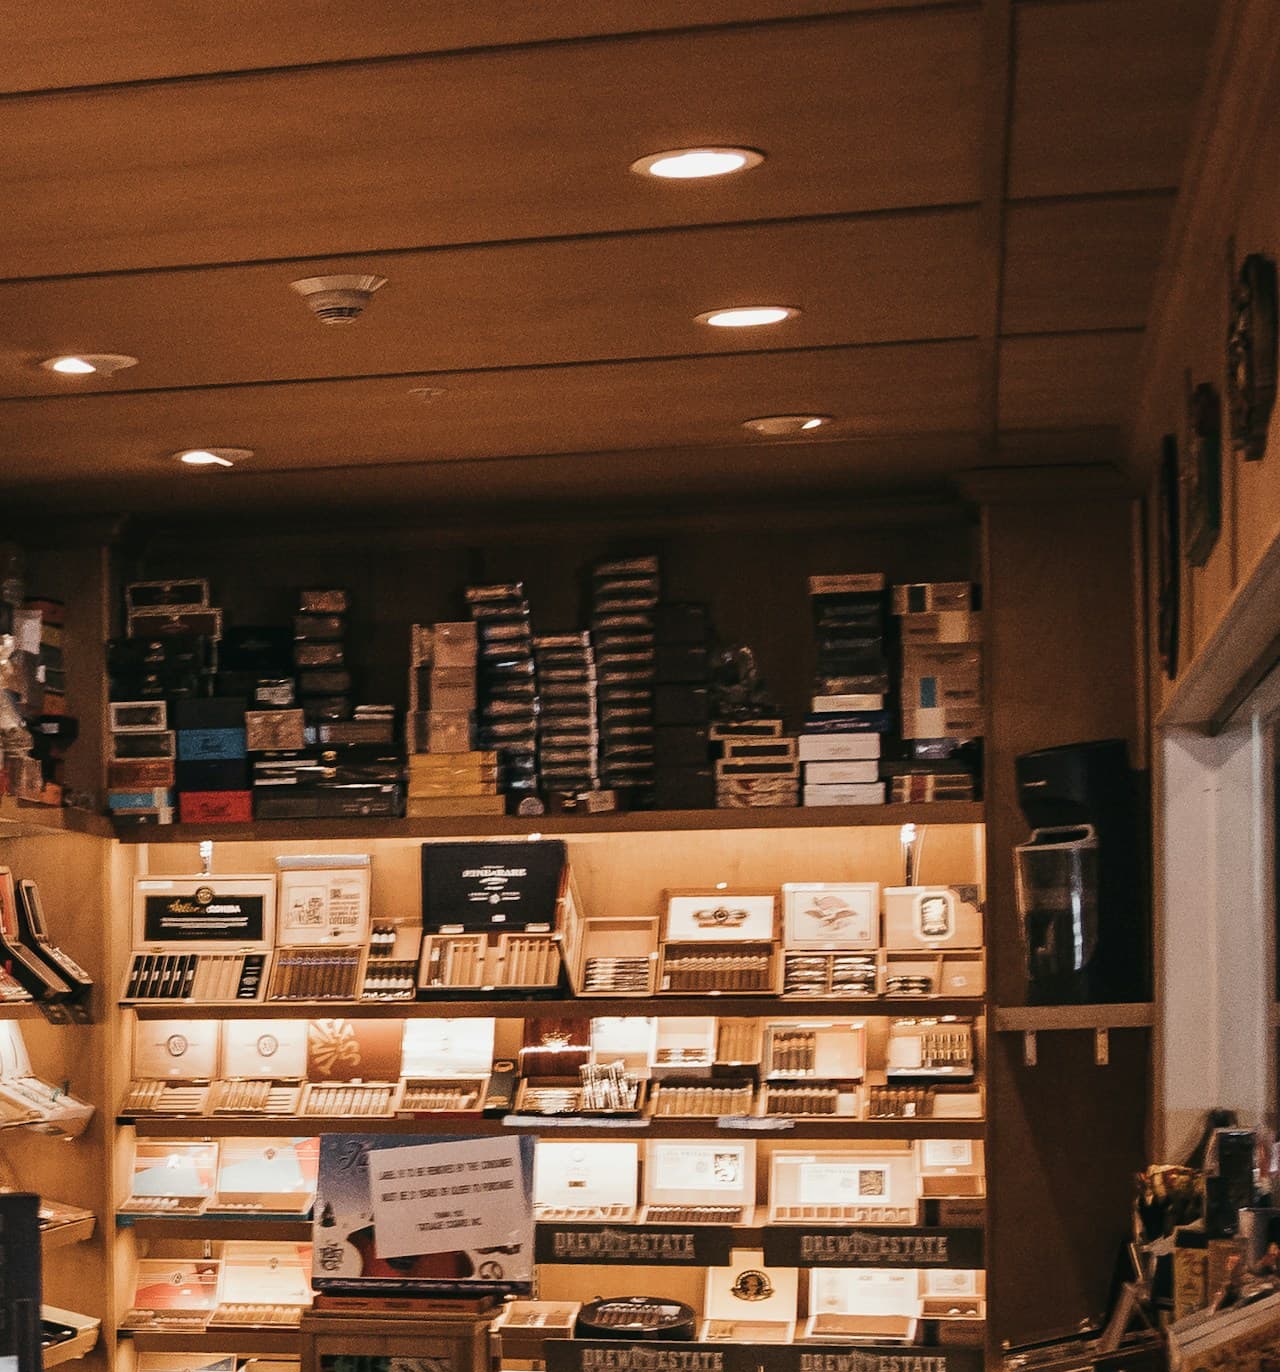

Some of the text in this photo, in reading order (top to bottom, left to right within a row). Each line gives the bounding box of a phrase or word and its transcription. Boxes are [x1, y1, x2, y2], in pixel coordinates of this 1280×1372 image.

[555, 1232, 695, 1251] DREW ESTATE
[801, 1235, 948, 1255] DREW ESTATE
[581, 1349, 723, 1371] DREW ESTATE
[801, 1353, 849, 1372] DREW
